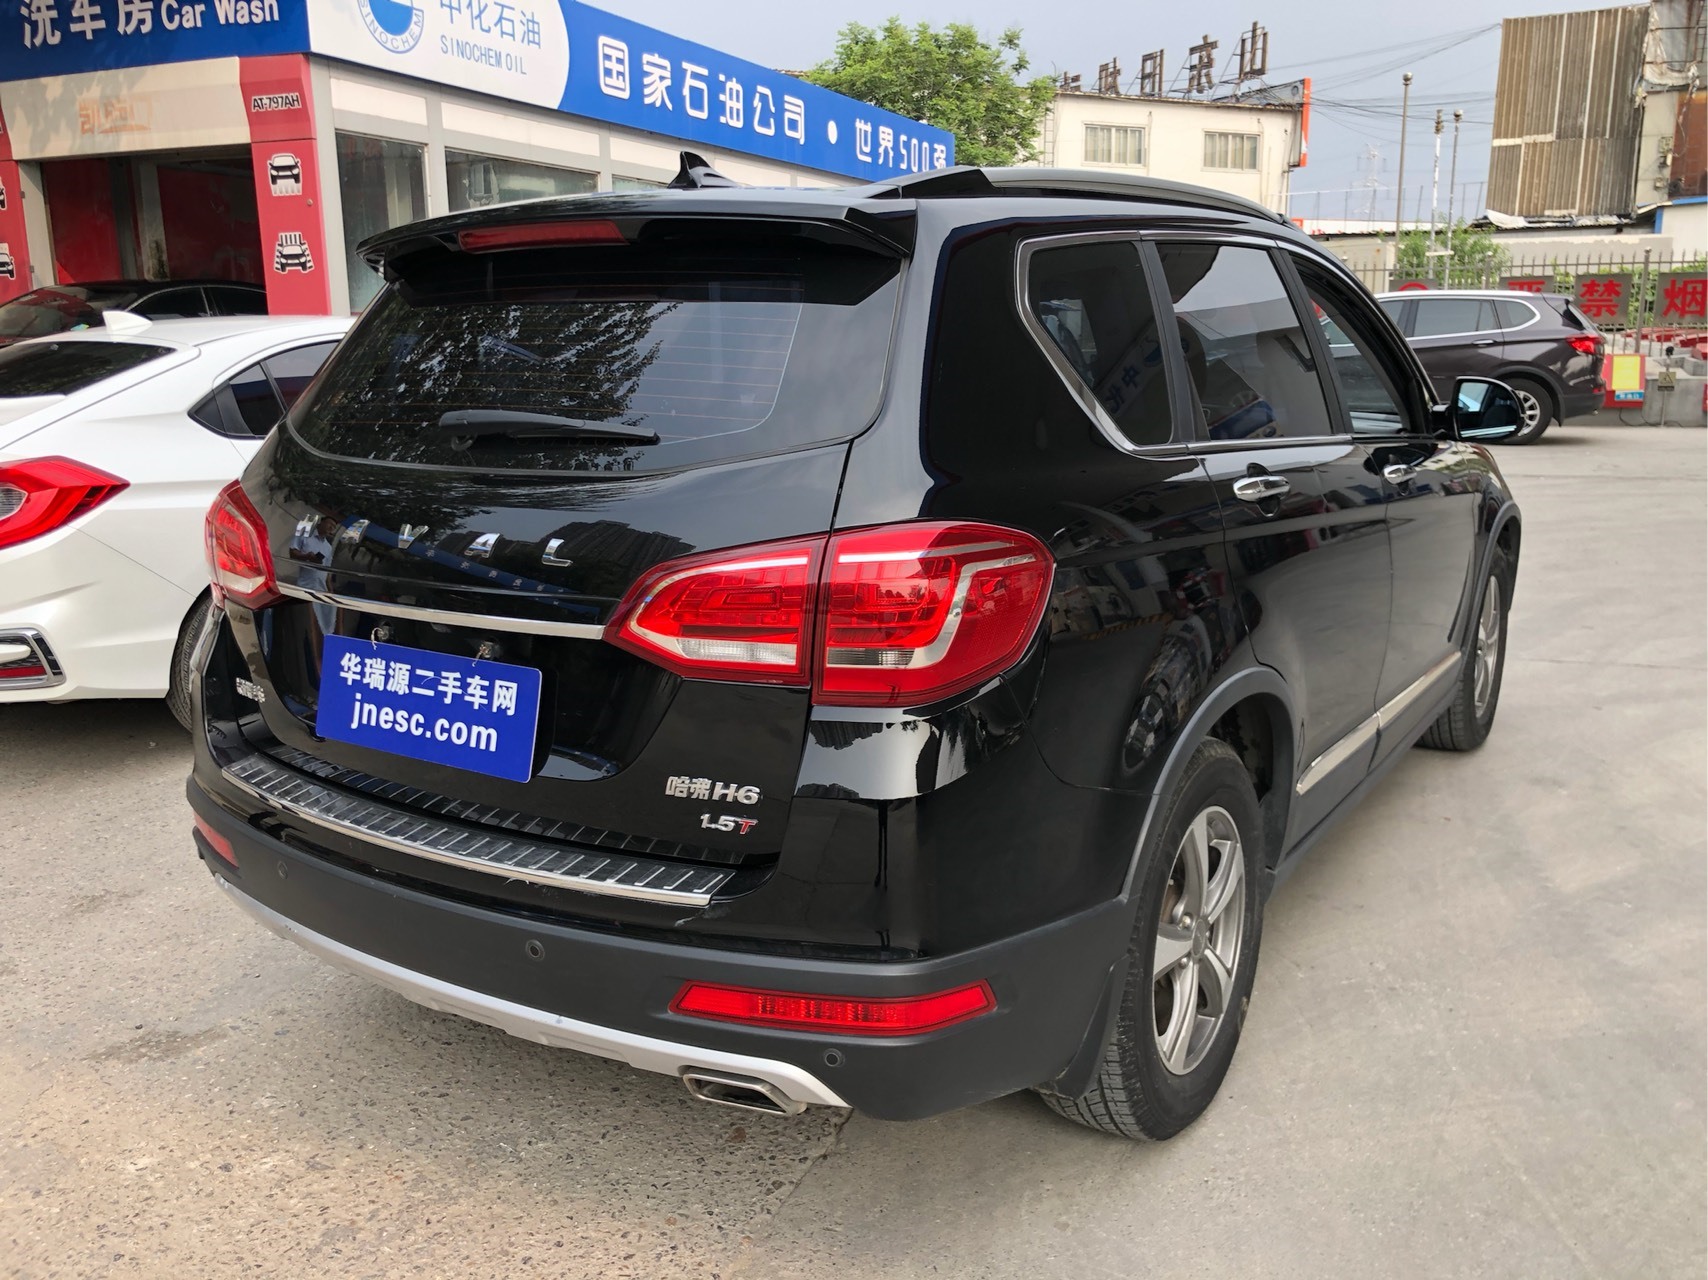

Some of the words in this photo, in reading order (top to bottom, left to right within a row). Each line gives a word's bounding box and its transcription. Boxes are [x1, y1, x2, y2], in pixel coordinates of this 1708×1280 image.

[161, 0, 205, 31] Car
[216, 0, 280, 25] Wash
[440, 35, 502, 68] SINOCHEM
[506, 53, 527, 75] OIL
[252, 94, 301, 111] AT-797AH
[295, 514, 573, 567] HAVAL
[340, 652, 518, 717] 华瑞源二手车网
[352, 694, 497, 752] jnesc.com
